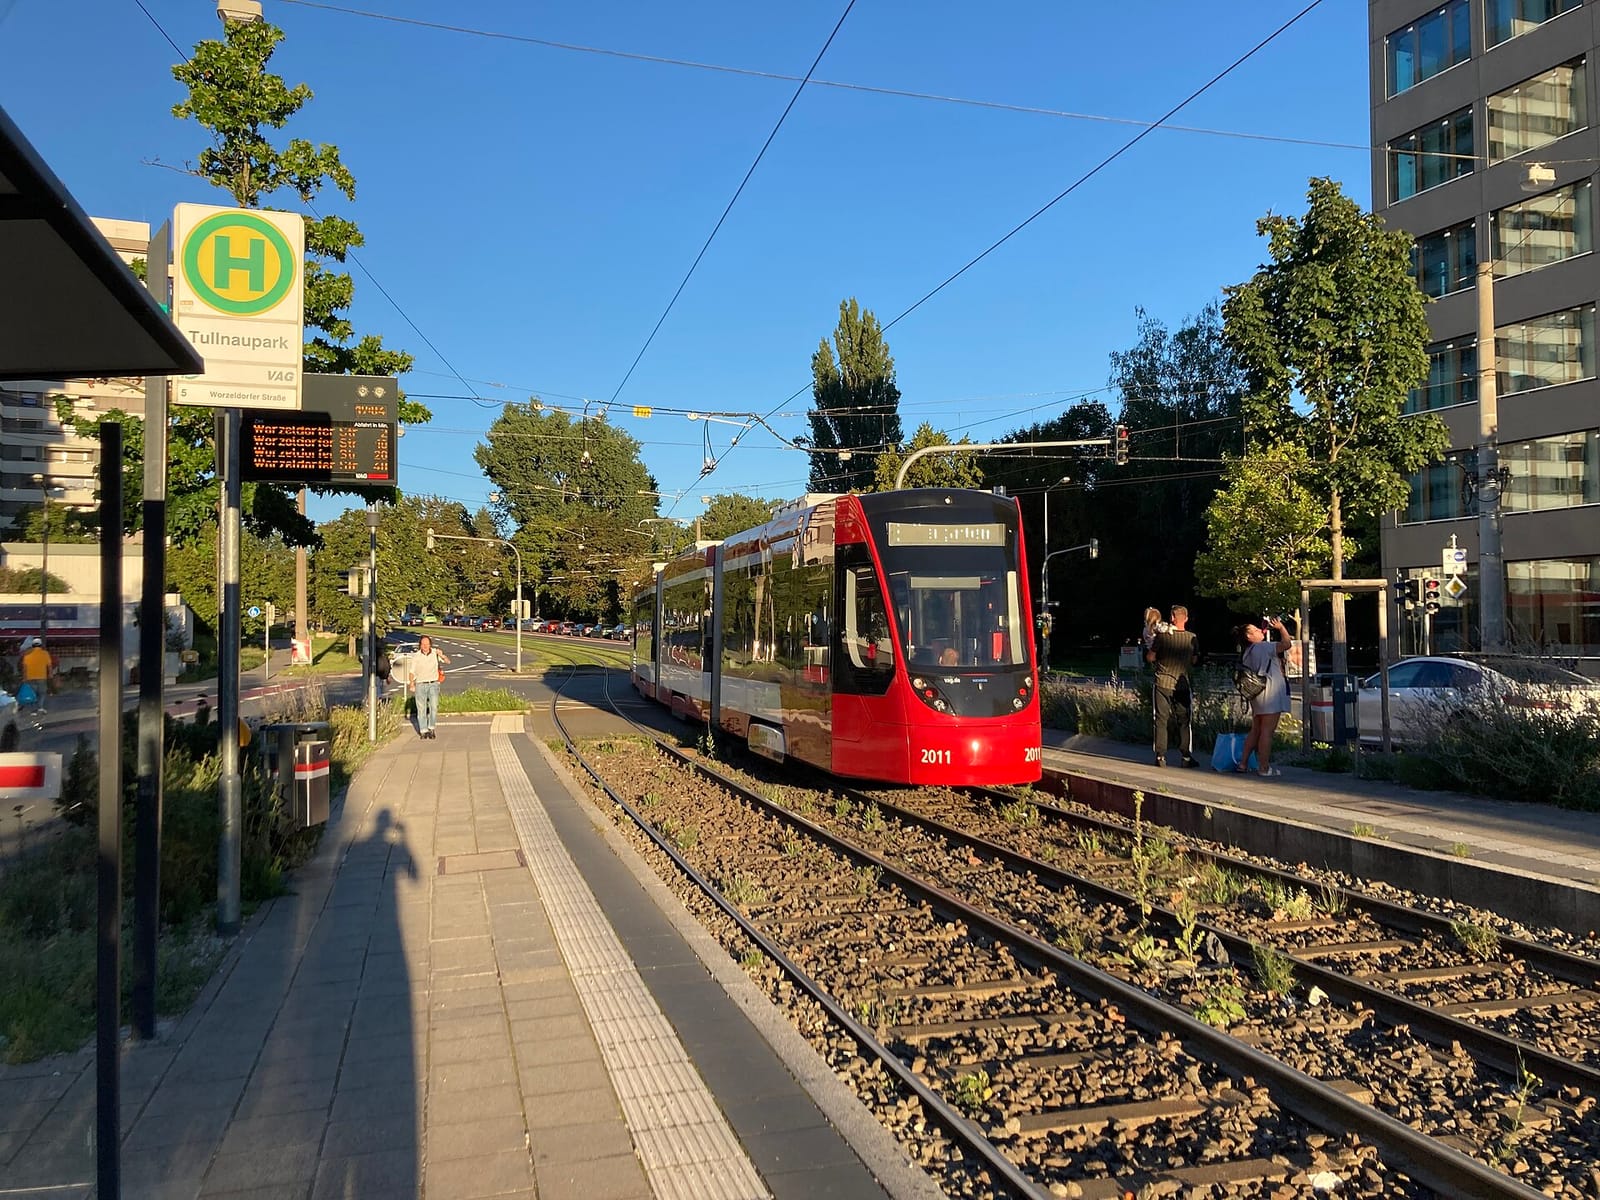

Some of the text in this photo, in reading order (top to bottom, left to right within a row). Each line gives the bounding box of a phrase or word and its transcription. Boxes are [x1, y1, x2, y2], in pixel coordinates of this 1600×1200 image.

[214, 235, 265, 291] H
[188, 330, 289, 351] Tullnaupark
[267, 370, 295, 382] VAG
[180, 388, 287, 402] 5 Worzeldorfer Straße
[921, 749, 951, 764] 2011
[1024, 747, 1041, 762] 2011
